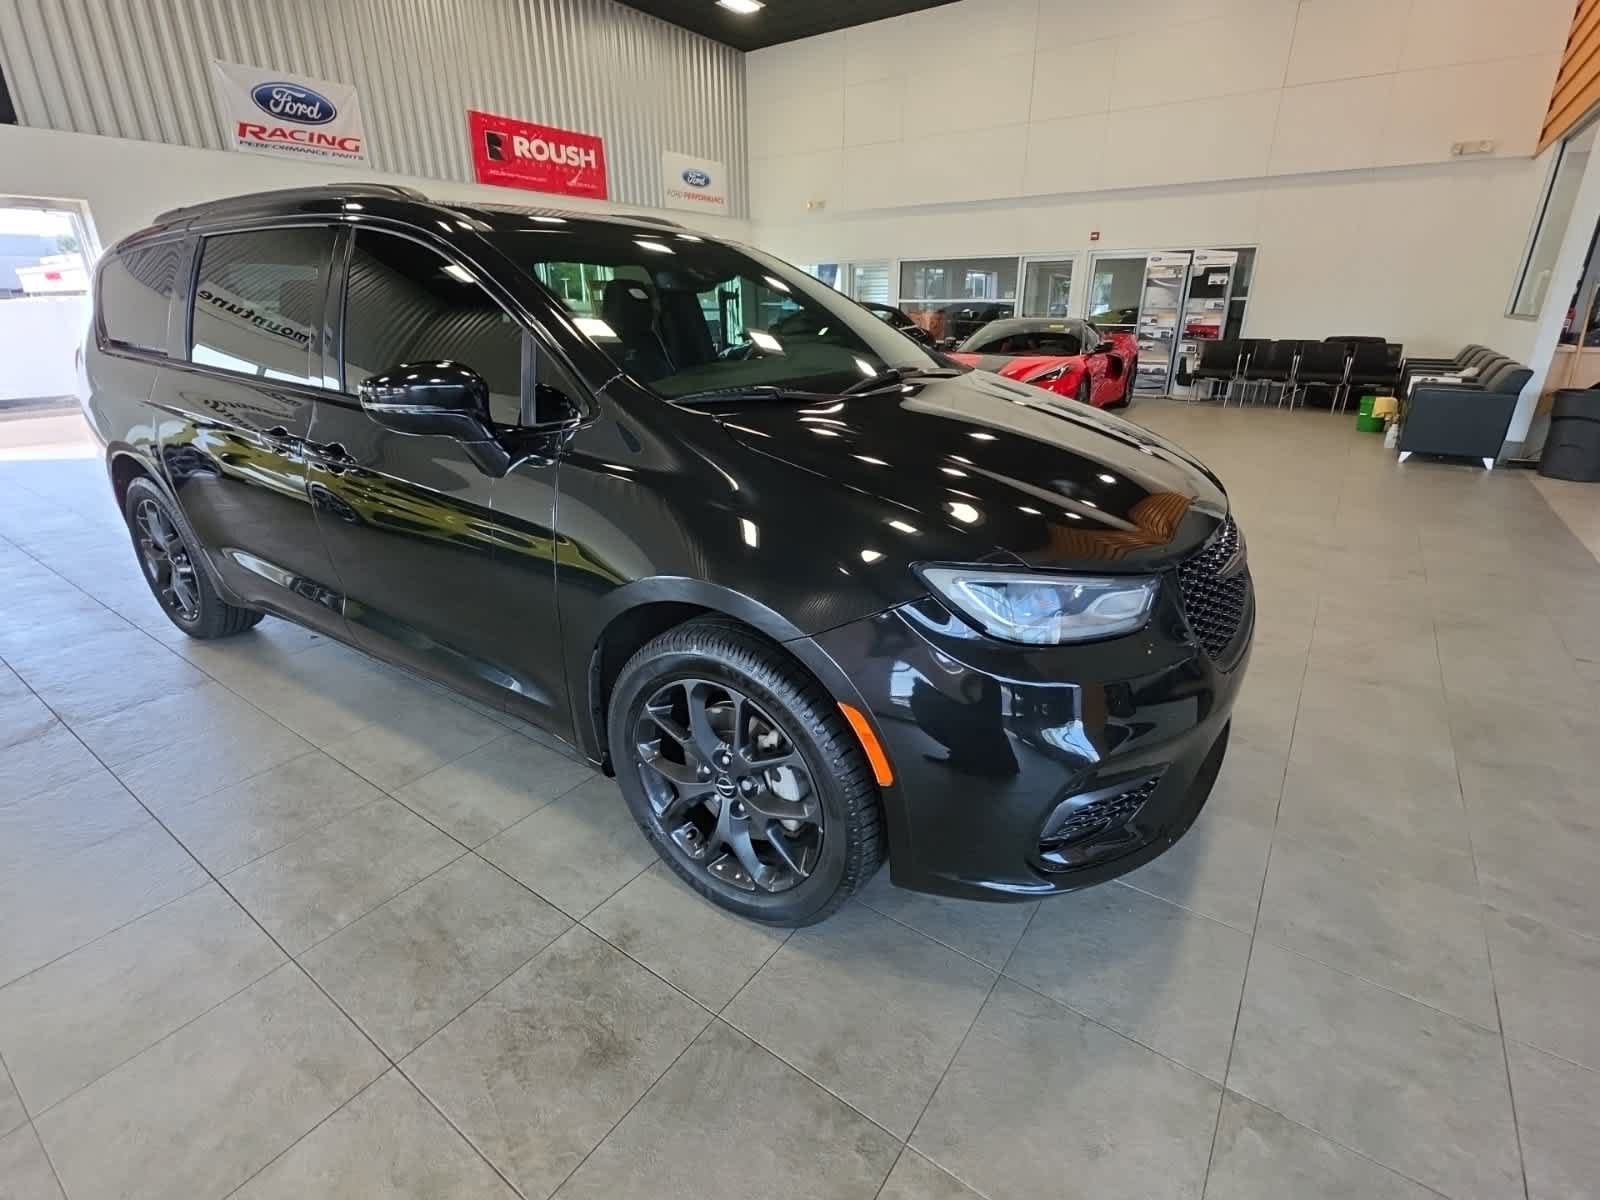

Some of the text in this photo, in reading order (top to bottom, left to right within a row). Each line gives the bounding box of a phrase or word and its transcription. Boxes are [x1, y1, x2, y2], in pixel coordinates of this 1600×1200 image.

[269, 87, 322, 119] Ford
[238, 122, 361, 153] RACING
[239, 140, 365, 161] PERFORMANCE PARTS
[512, 135, 597, 169] ROUSH
